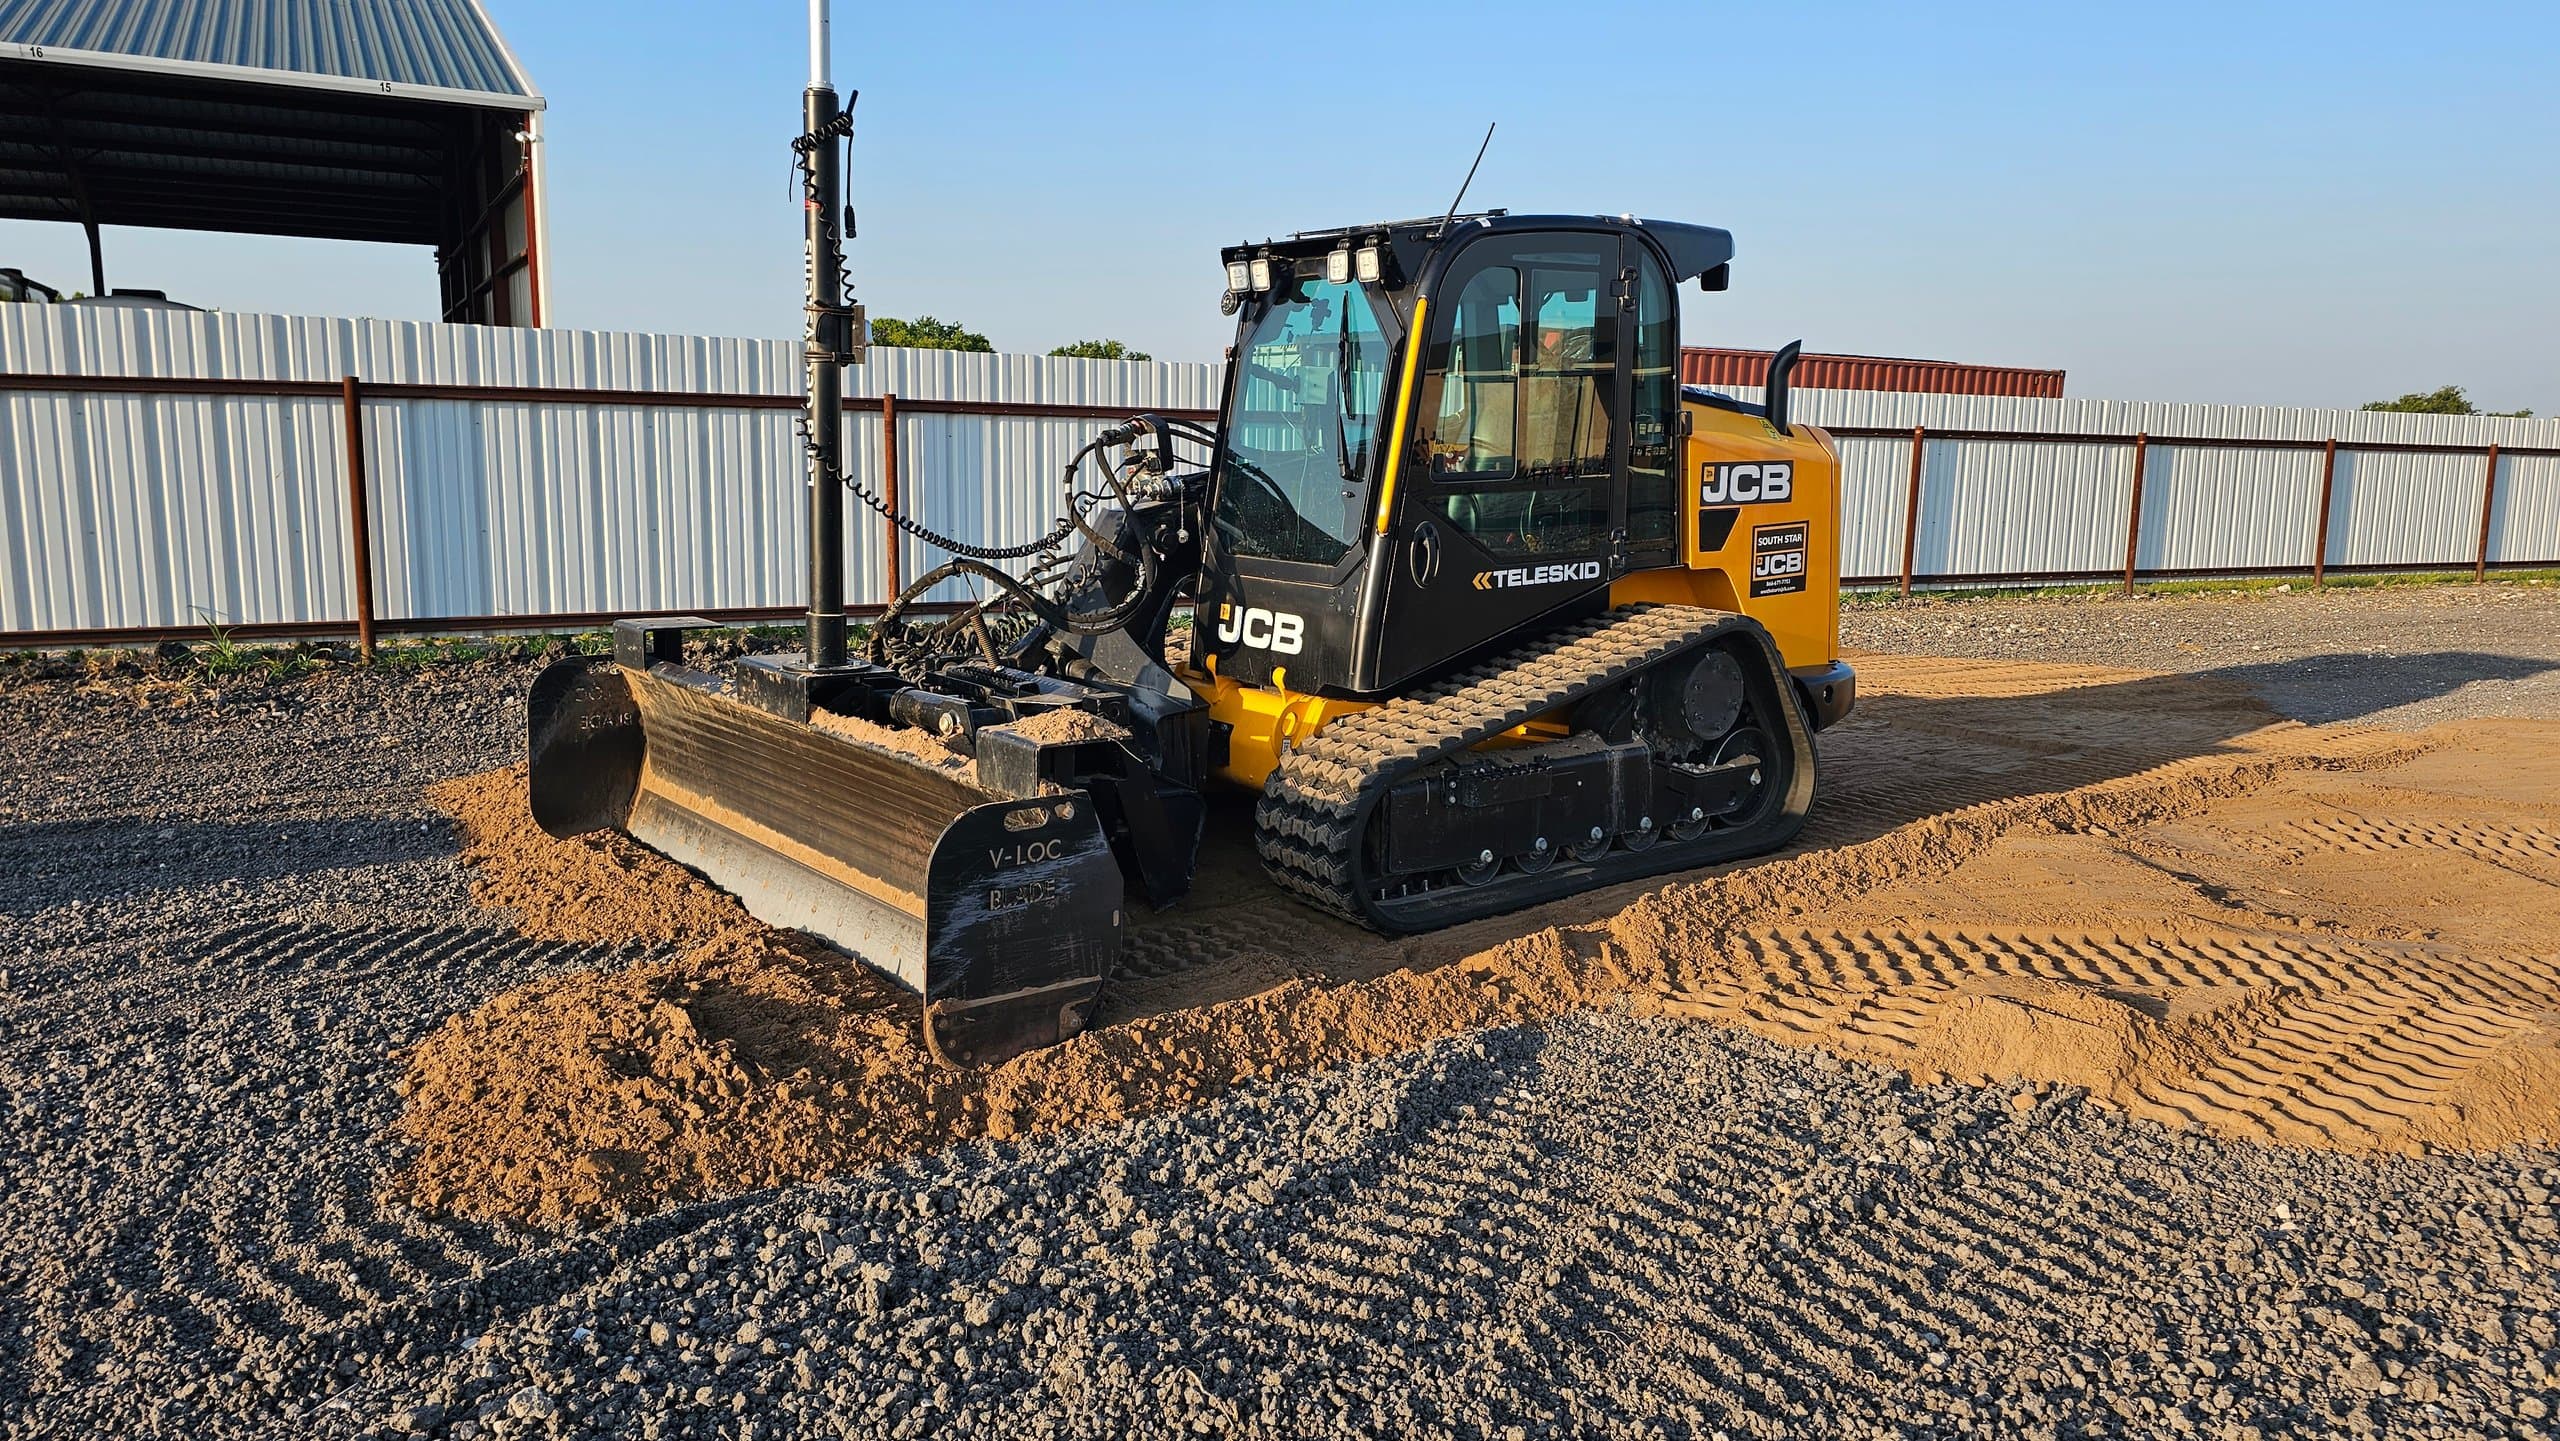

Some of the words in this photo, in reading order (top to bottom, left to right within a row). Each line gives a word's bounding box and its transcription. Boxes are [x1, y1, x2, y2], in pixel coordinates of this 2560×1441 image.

[30, 46, 44, 58] 16
[380, 82, 392, 93] 15
[1703, 464, 1791, 502] JCB
[1758, 535, 1783, 546] SOUTH
[1784, 533, 1803, 543] STAR
[1493, 561, 1600, 588] TELESKID
[1757, 552, 1801, 576] JCB
[1218, 605, 1304, 655] JCB
[989, 838, 1061, 870] V-LOC
[990, 879, 1056, 911] BLADE
